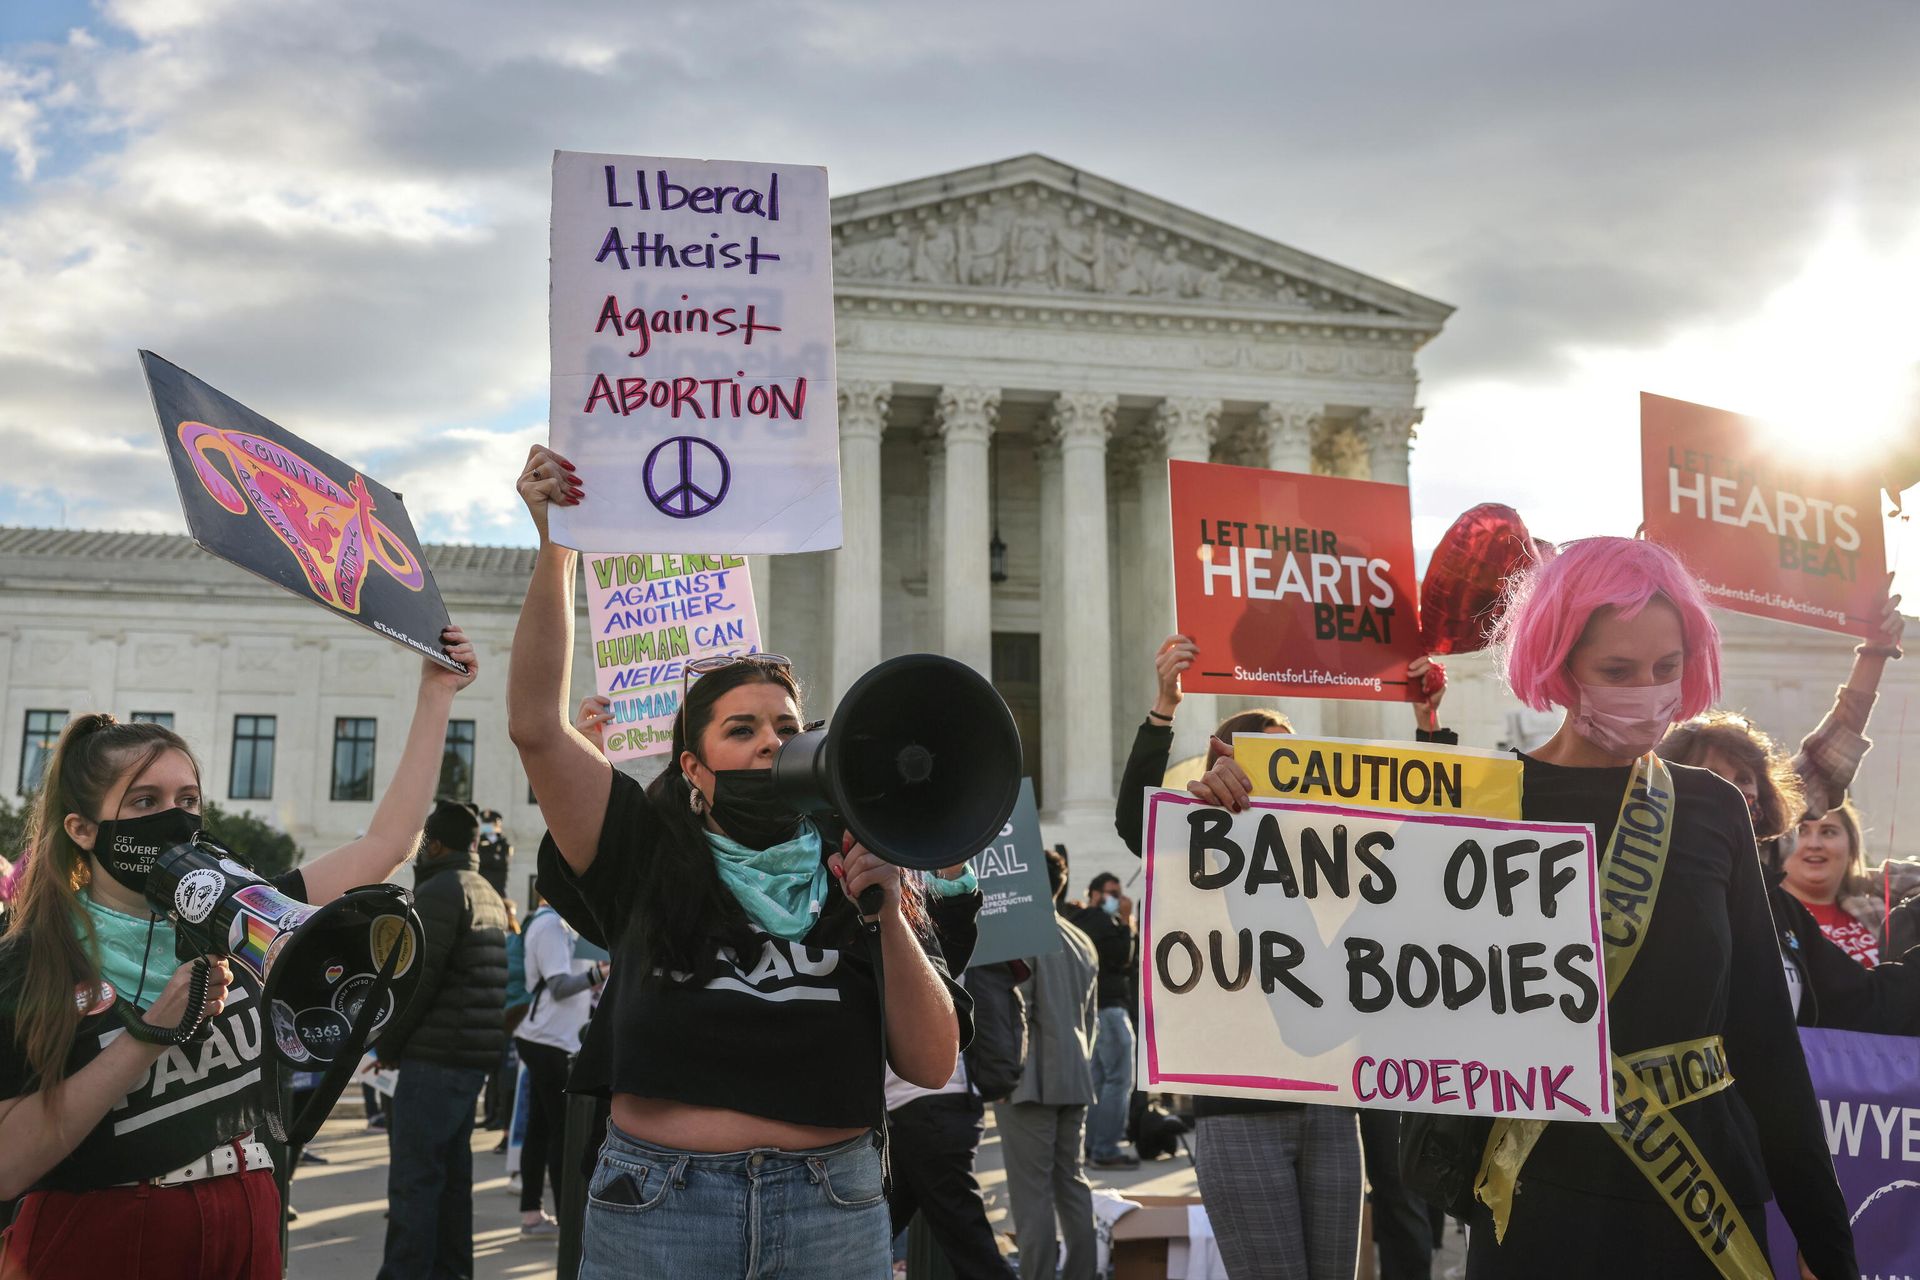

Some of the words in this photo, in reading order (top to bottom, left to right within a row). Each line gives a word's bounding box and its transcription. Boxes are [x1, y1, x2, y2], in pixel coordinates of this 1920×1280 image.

[595, 226, 780, 275] Atheist
[595, 294, 782, 358] Against
[241, 439, 340, 502] COUNTER
[1669, 467, 1861, 551] HEARTS
[1201, 518, 1248, 547] LET
[1255, 523, 1338, 555] THEIR
[1779, 535, 1861, 583] BEAT
[604, 570, 730, 610] AGAINST
[1202, 544, 1395, 608] HEARTS
[604, 592, 736, 634] ANOTHER
[1314, 603, 1395, 644] BEAT
[1698, 578, 1846, 625] StudentsforLifeAction.org
[596, 625, 690, 668] HUMAN
[694, 619, 744, 646] CAN
[1234, 666, 1382, 692] StudentsforLifeAction.org
[1268, 747, 1463, 808] CAUTION
[113, 843, 161, 855] COVERE
[115, 835, 135, 844] GET
[1601, 776, 1669, 948] CAUTION
[113, 861, 153, 873] COVER
[180, 870, 206, 887] ANIMAL
[206, 871, 222, 897] LIBERATION
[1187, 808, 1398, 905] BANS
[1443, 839, 1585, 919] OFF
[176, 892, 187, 916] HUMAN
[983, 892, 1007, 902] ENTER
[1155, 928, 1324, 1009] OUR
[1343, 936, 1600, 1024] BODIES
[301, 1024, 341, 1040] 2,363
[1351, 1055, 1592, 1117] CODEPINK
